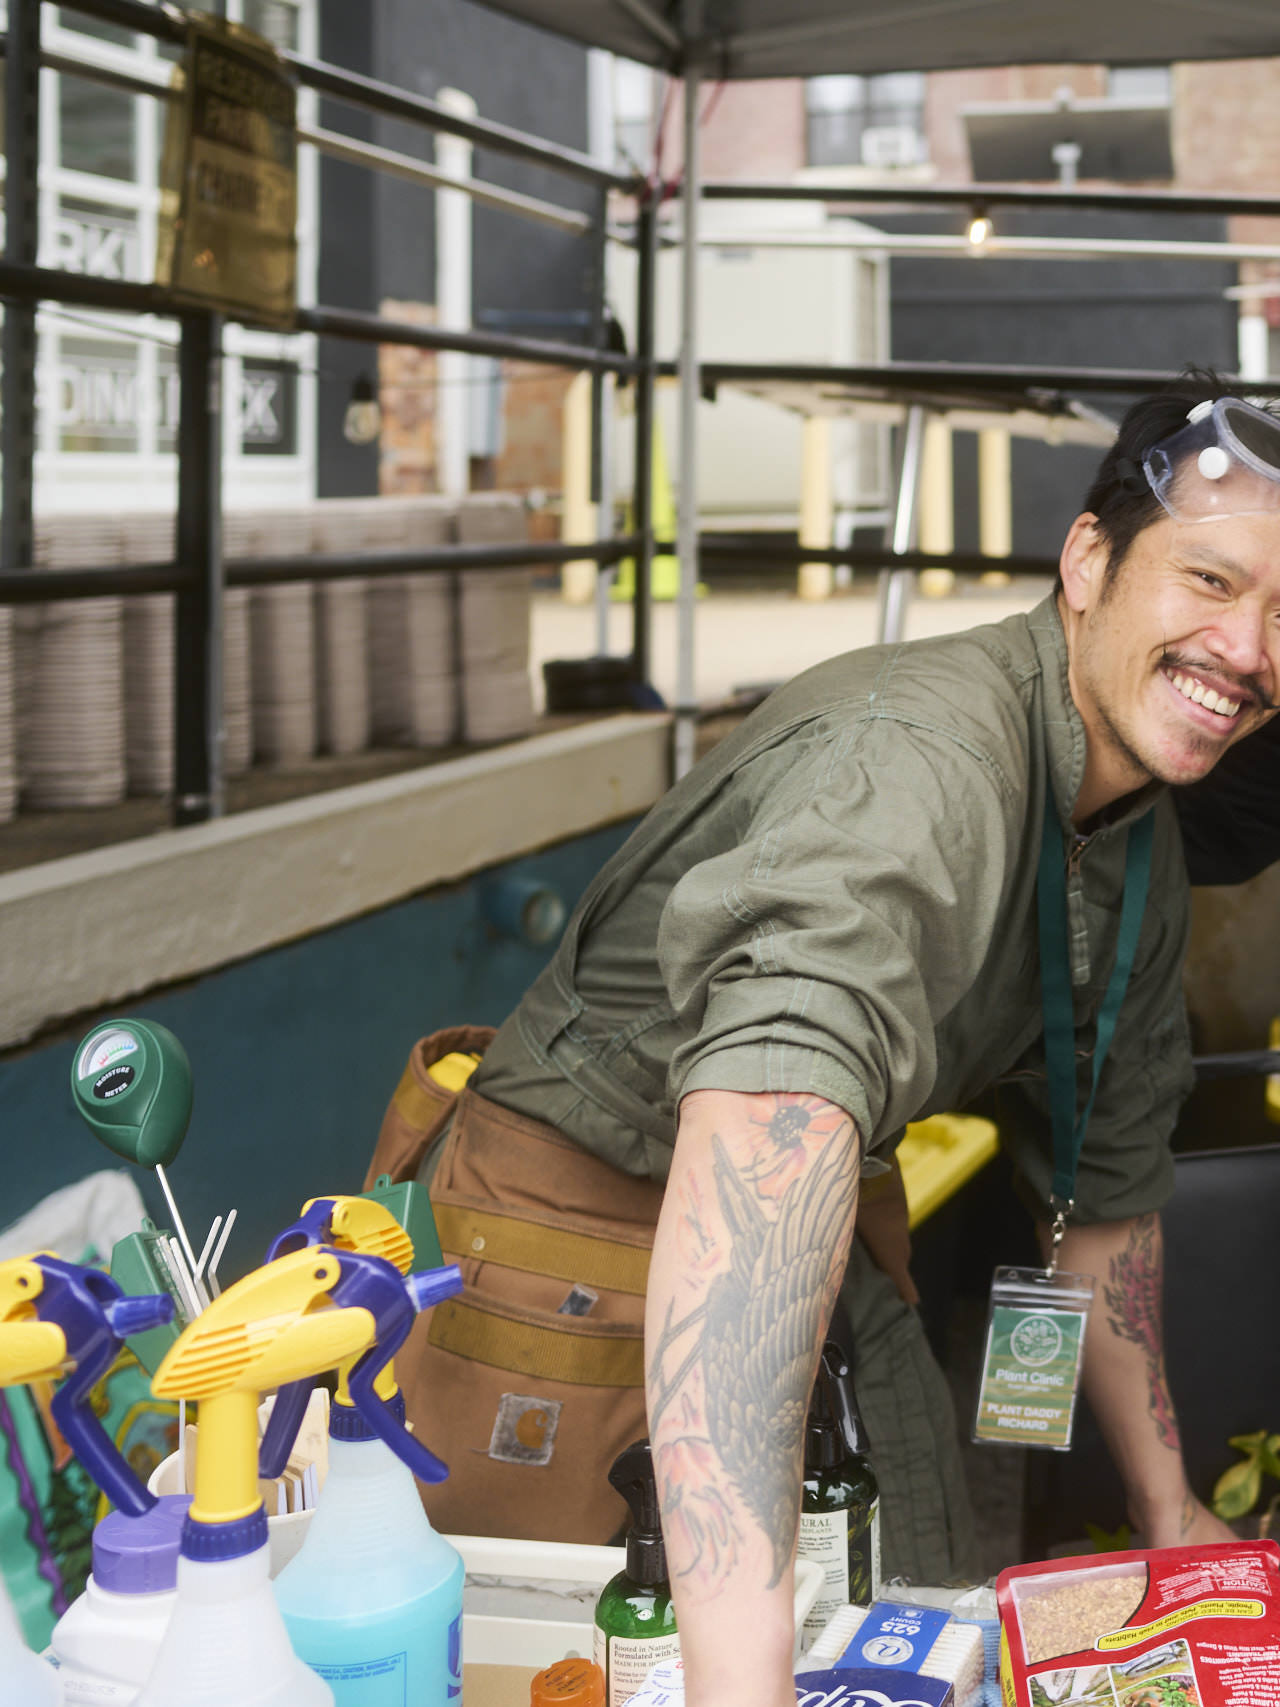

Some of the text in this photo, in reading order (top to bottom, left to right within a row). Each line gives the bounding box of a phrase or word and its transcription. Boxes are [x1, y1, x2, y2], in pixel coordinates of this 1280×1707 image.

[96, 1067, 130, 1087] MOISTURE
[104, 1082, 128, 1098] METER
[996, 1369, 1064, 1386] Plant Clinic
[987, 1403, 1062, 1418] PLANT DADDY
[998, 1417, 1048, 1431] RICHARD
[880, 1621, 920, 1636] 625
[889, 1616, 921, 1626] COUNT
[615, 1644, 637, 1652] Rooted
